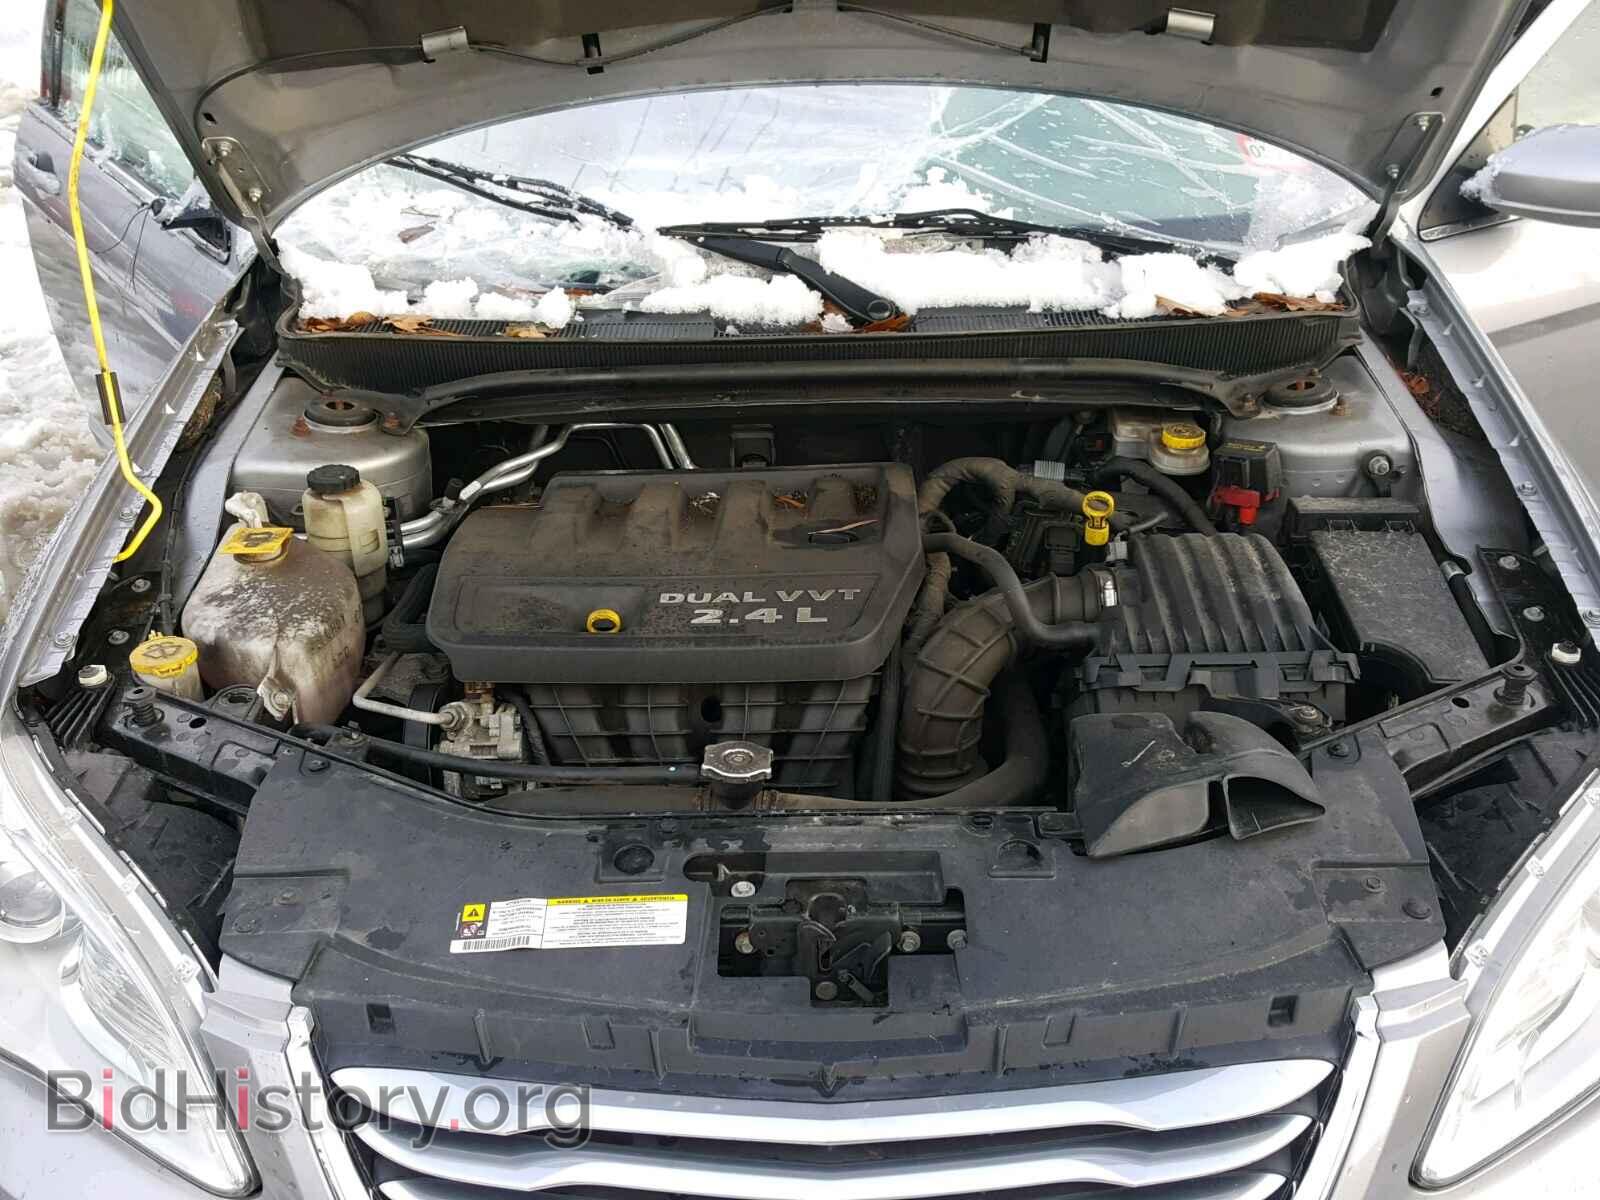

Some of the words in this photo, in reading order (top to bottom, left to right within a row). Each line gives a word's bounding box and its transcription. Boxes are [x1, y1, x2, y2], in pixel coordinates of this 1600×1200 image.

[659, 591, 767, 604] DUAL
[775, 588, 862, 602] VVT
[690, 607, 784, 624] 2.4
[796, 607, 829, 623] L
